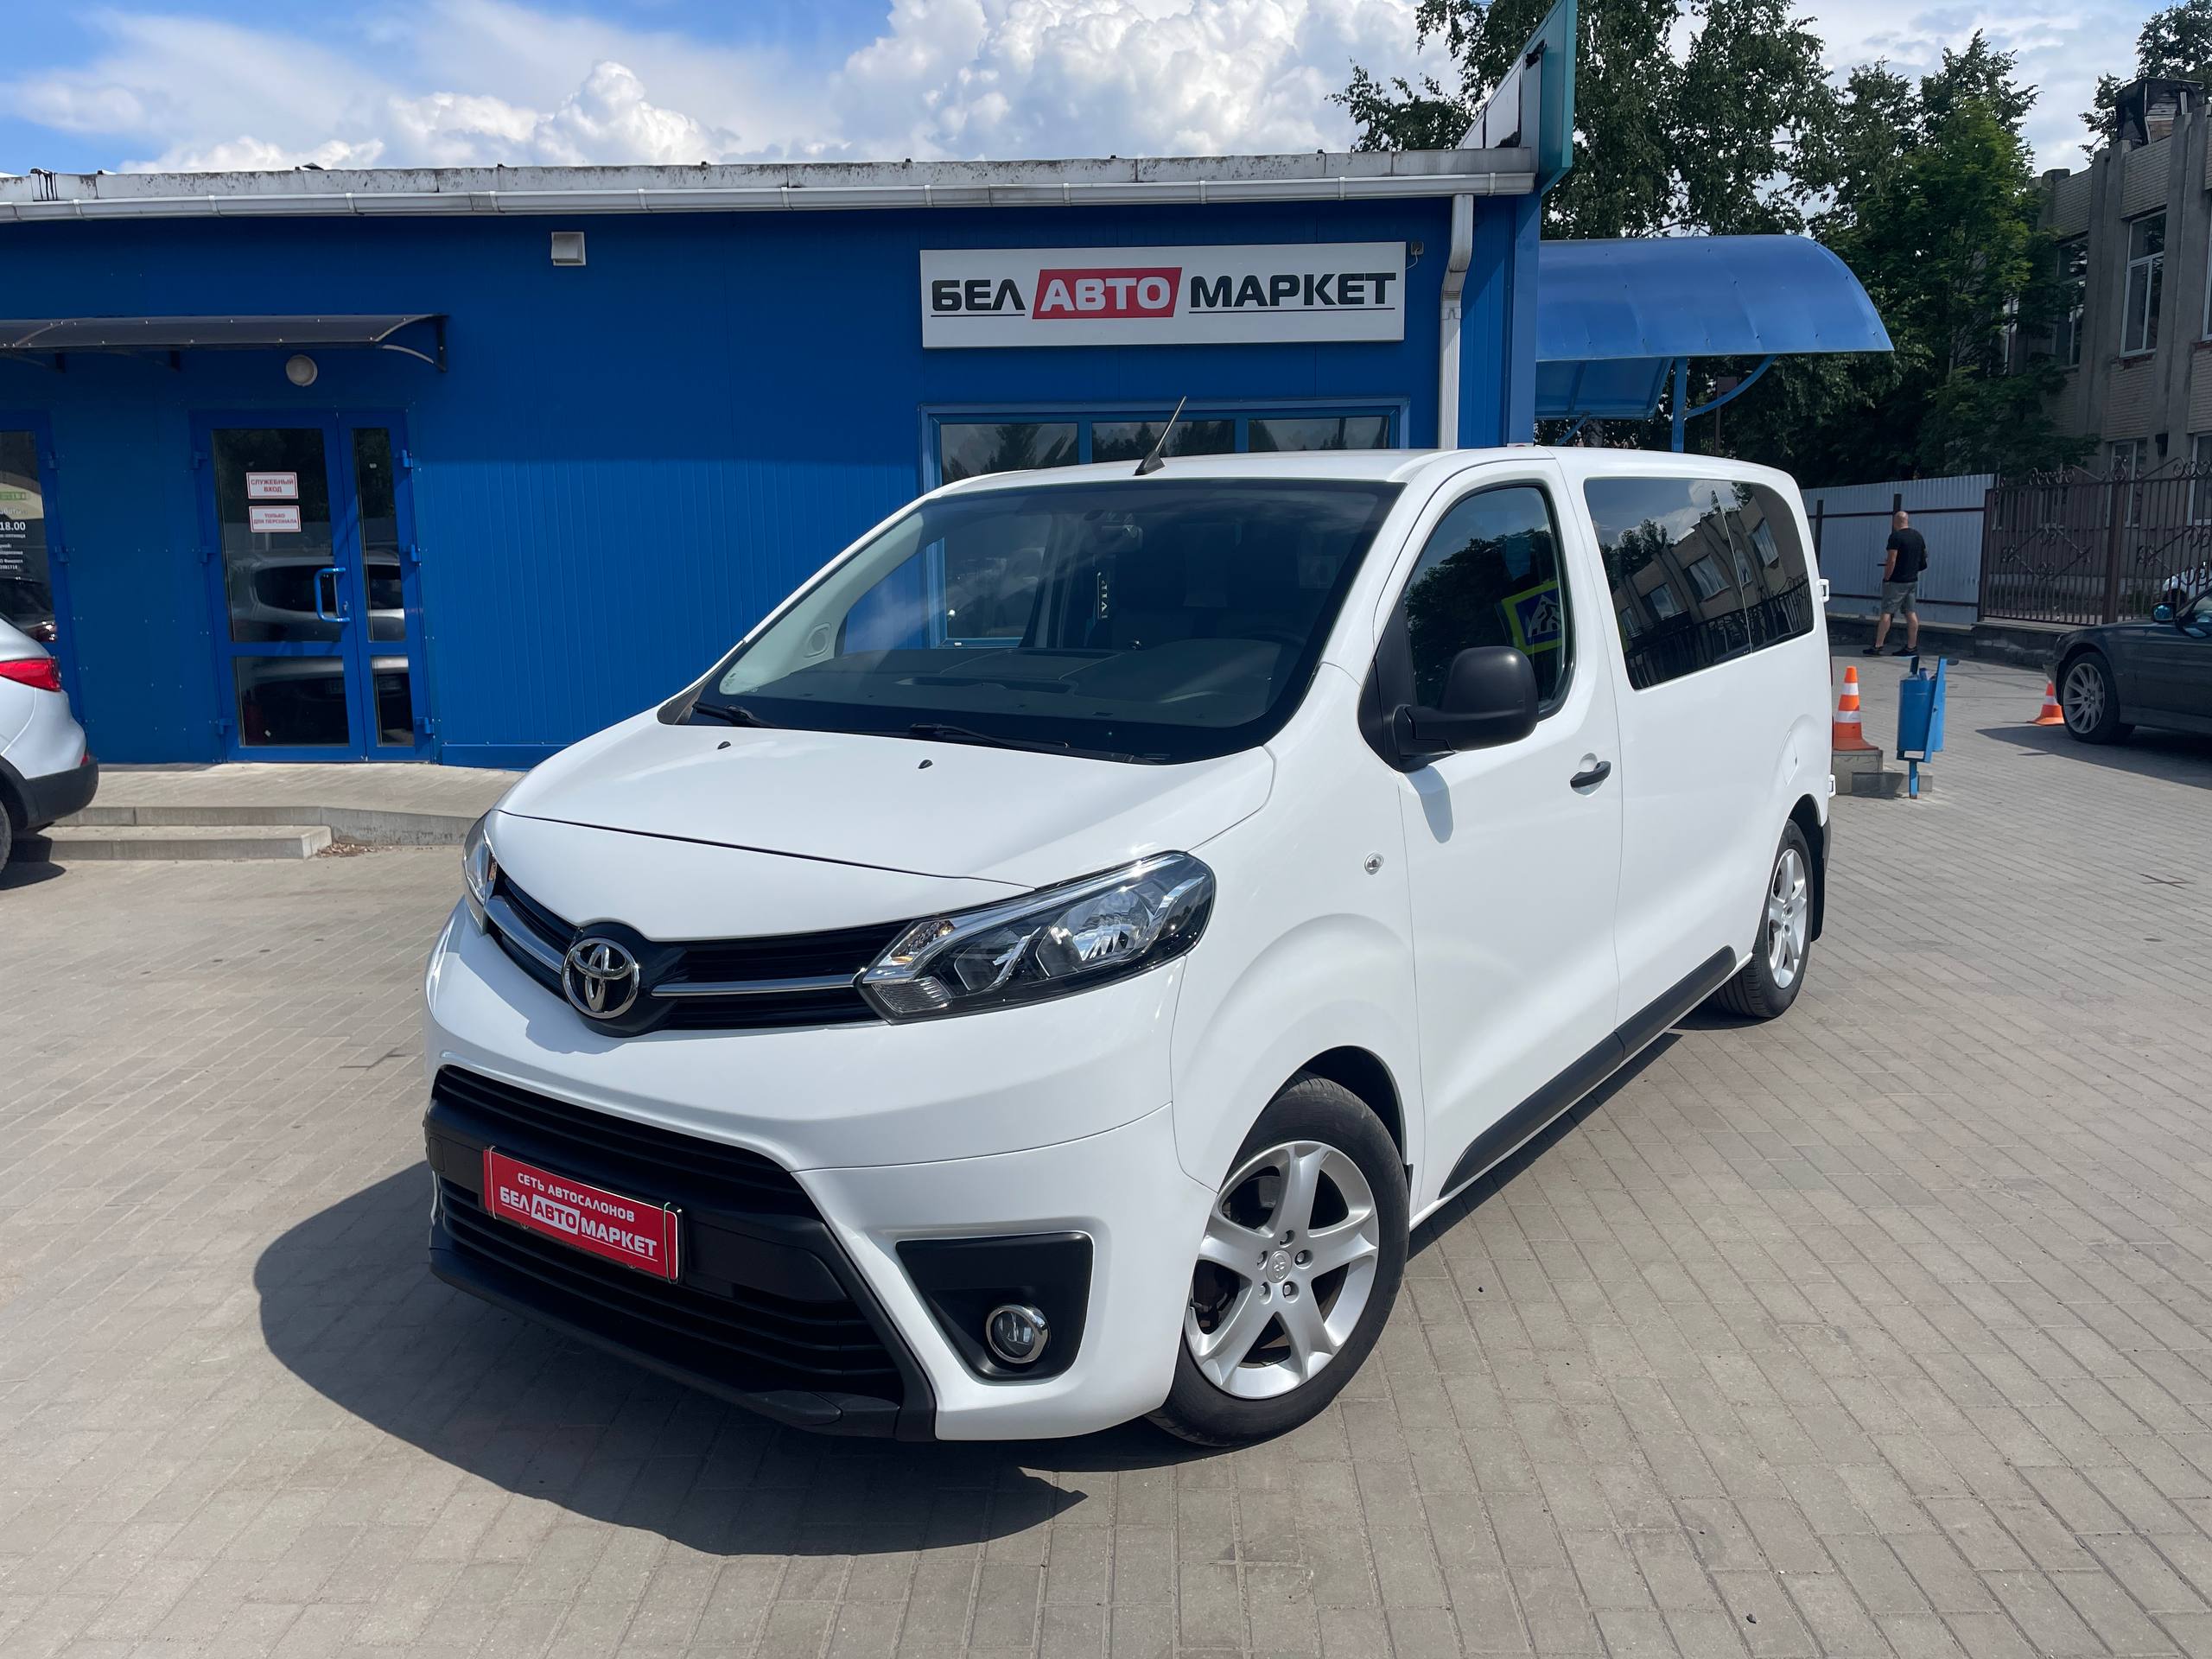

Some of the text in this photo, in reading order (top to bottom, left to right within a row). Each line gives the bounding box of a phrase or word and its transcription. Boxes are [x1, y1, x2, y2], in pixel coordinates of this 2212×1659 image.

[1039, 276, 1172, 313] АВТО
[1189, 271, 1397, 308] МАРКЕТ
[517, 1172, 636, 1224] СЕТЬ АВТОСАЛОНОВ
[580, 1217, 658, 1257] МАРКЕТ
